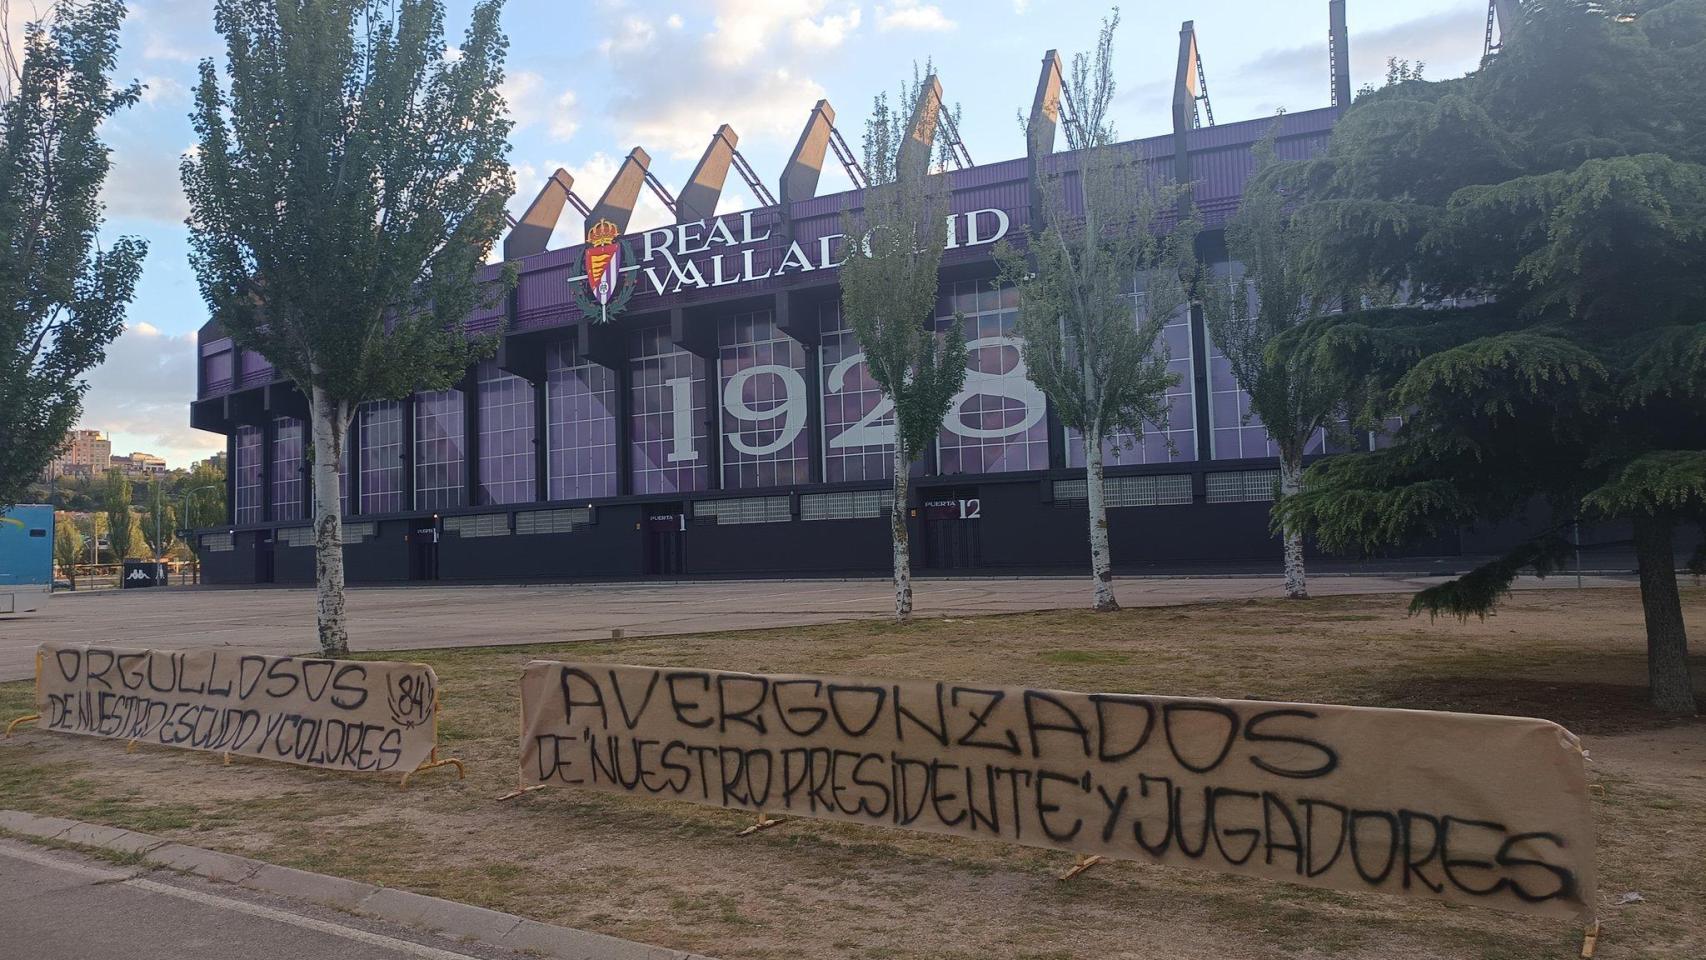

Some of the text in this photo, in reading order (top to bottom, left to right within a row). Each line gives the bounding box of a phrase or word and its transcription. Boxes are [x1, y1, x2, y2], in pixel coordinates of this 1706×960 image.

[642, 211, 771, 274] REAL
[665, 336, 1047, 462] 1928
[959, 499, 981, 519] 12
[55, 648, 368, 710] ORGULLOSOS
[47, 690, 403, 772] DE NUESTRO ESCUDO Y COLORES
[560, 666, 1340, 779] AVERGONZADOS
[537, 733, 584, 785] DE
[1097, 784, 1130, 844] Y
[1133, 772, 1580, 903] JUGADORES
